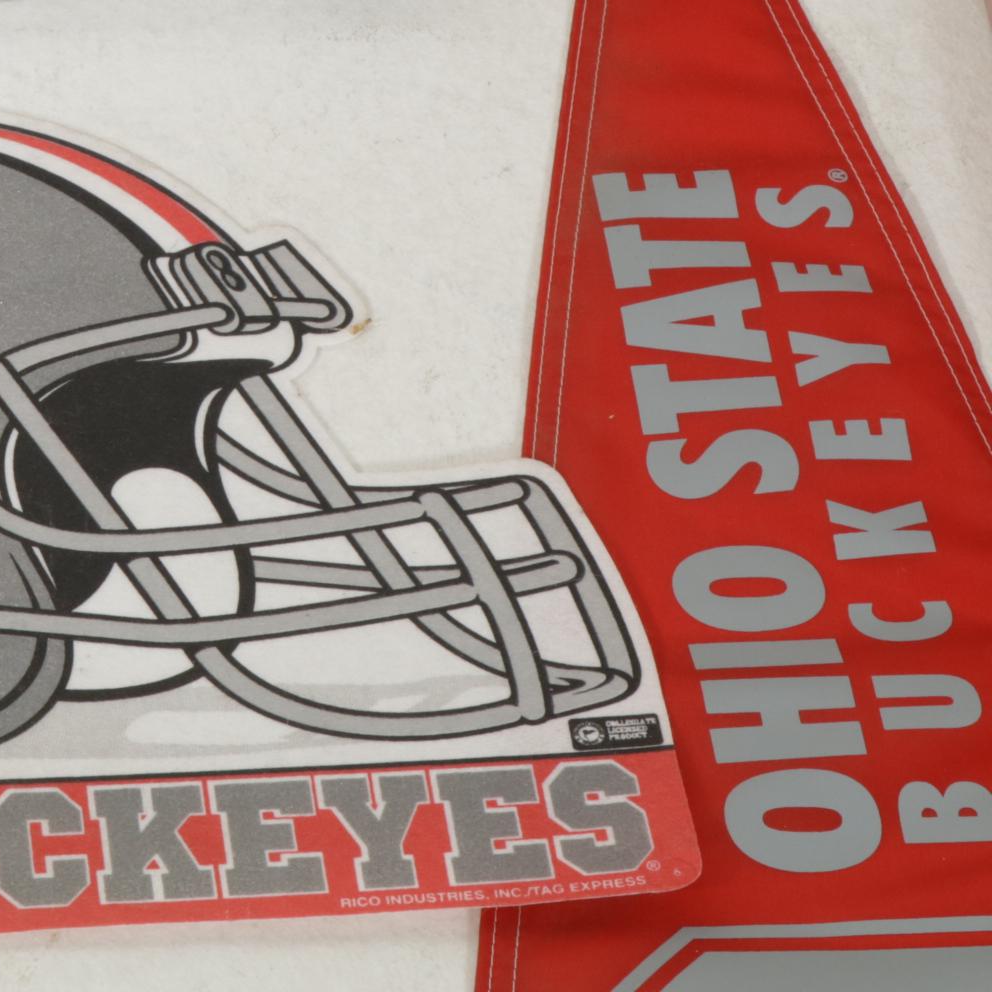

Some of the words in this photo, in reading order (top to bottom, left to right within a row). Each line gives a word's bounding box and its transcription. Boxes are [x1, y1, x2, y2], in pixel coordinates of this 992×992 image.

[591, 169, 800, 500] STATE
[755, 184, 992, 844] BUCKEYES
[605, 717, 657, 727] COLLEGIATE
[608, 731, 648, 741] PRODUCT
[671, 545, 883, 873] OHIO
[340, 896, 382, 908] RICO
[569, 875, 647, 892] EXPRESS
